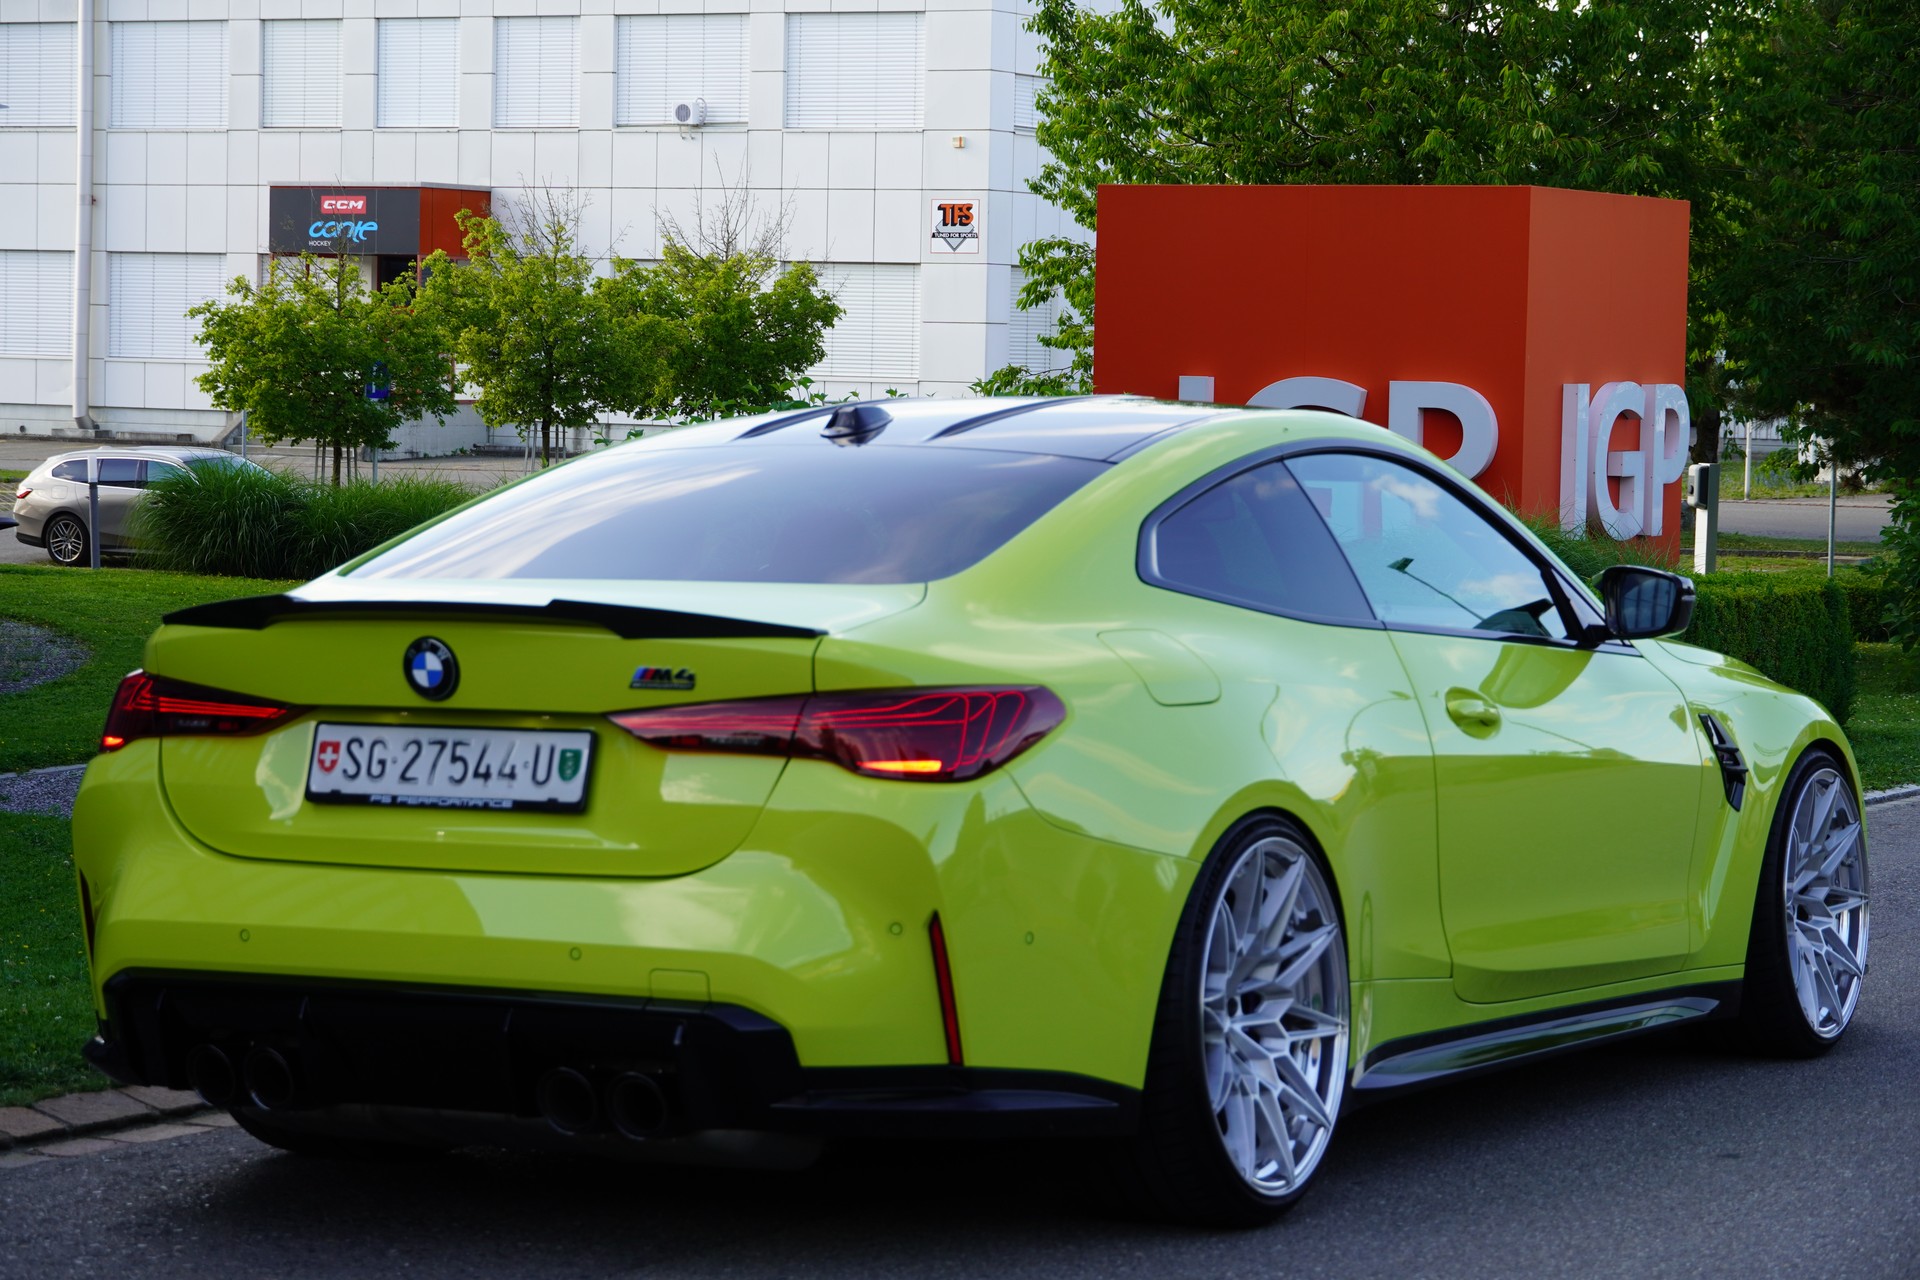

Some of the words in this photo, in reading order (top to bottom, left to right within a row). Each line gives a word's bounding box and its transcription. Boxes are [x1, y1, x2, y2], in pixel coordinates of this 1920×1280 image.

[323, 200, 363, 210] CCM
[937, 203, 974, 226] TFS
[1559, 381, 1690, 542] IGP
[342, 738, 388, 780] SG
[400, 739, 517, 787] 27544
[531, 743, 555, 786] U
[396, 795, 513, 808] PERFORMANCE
